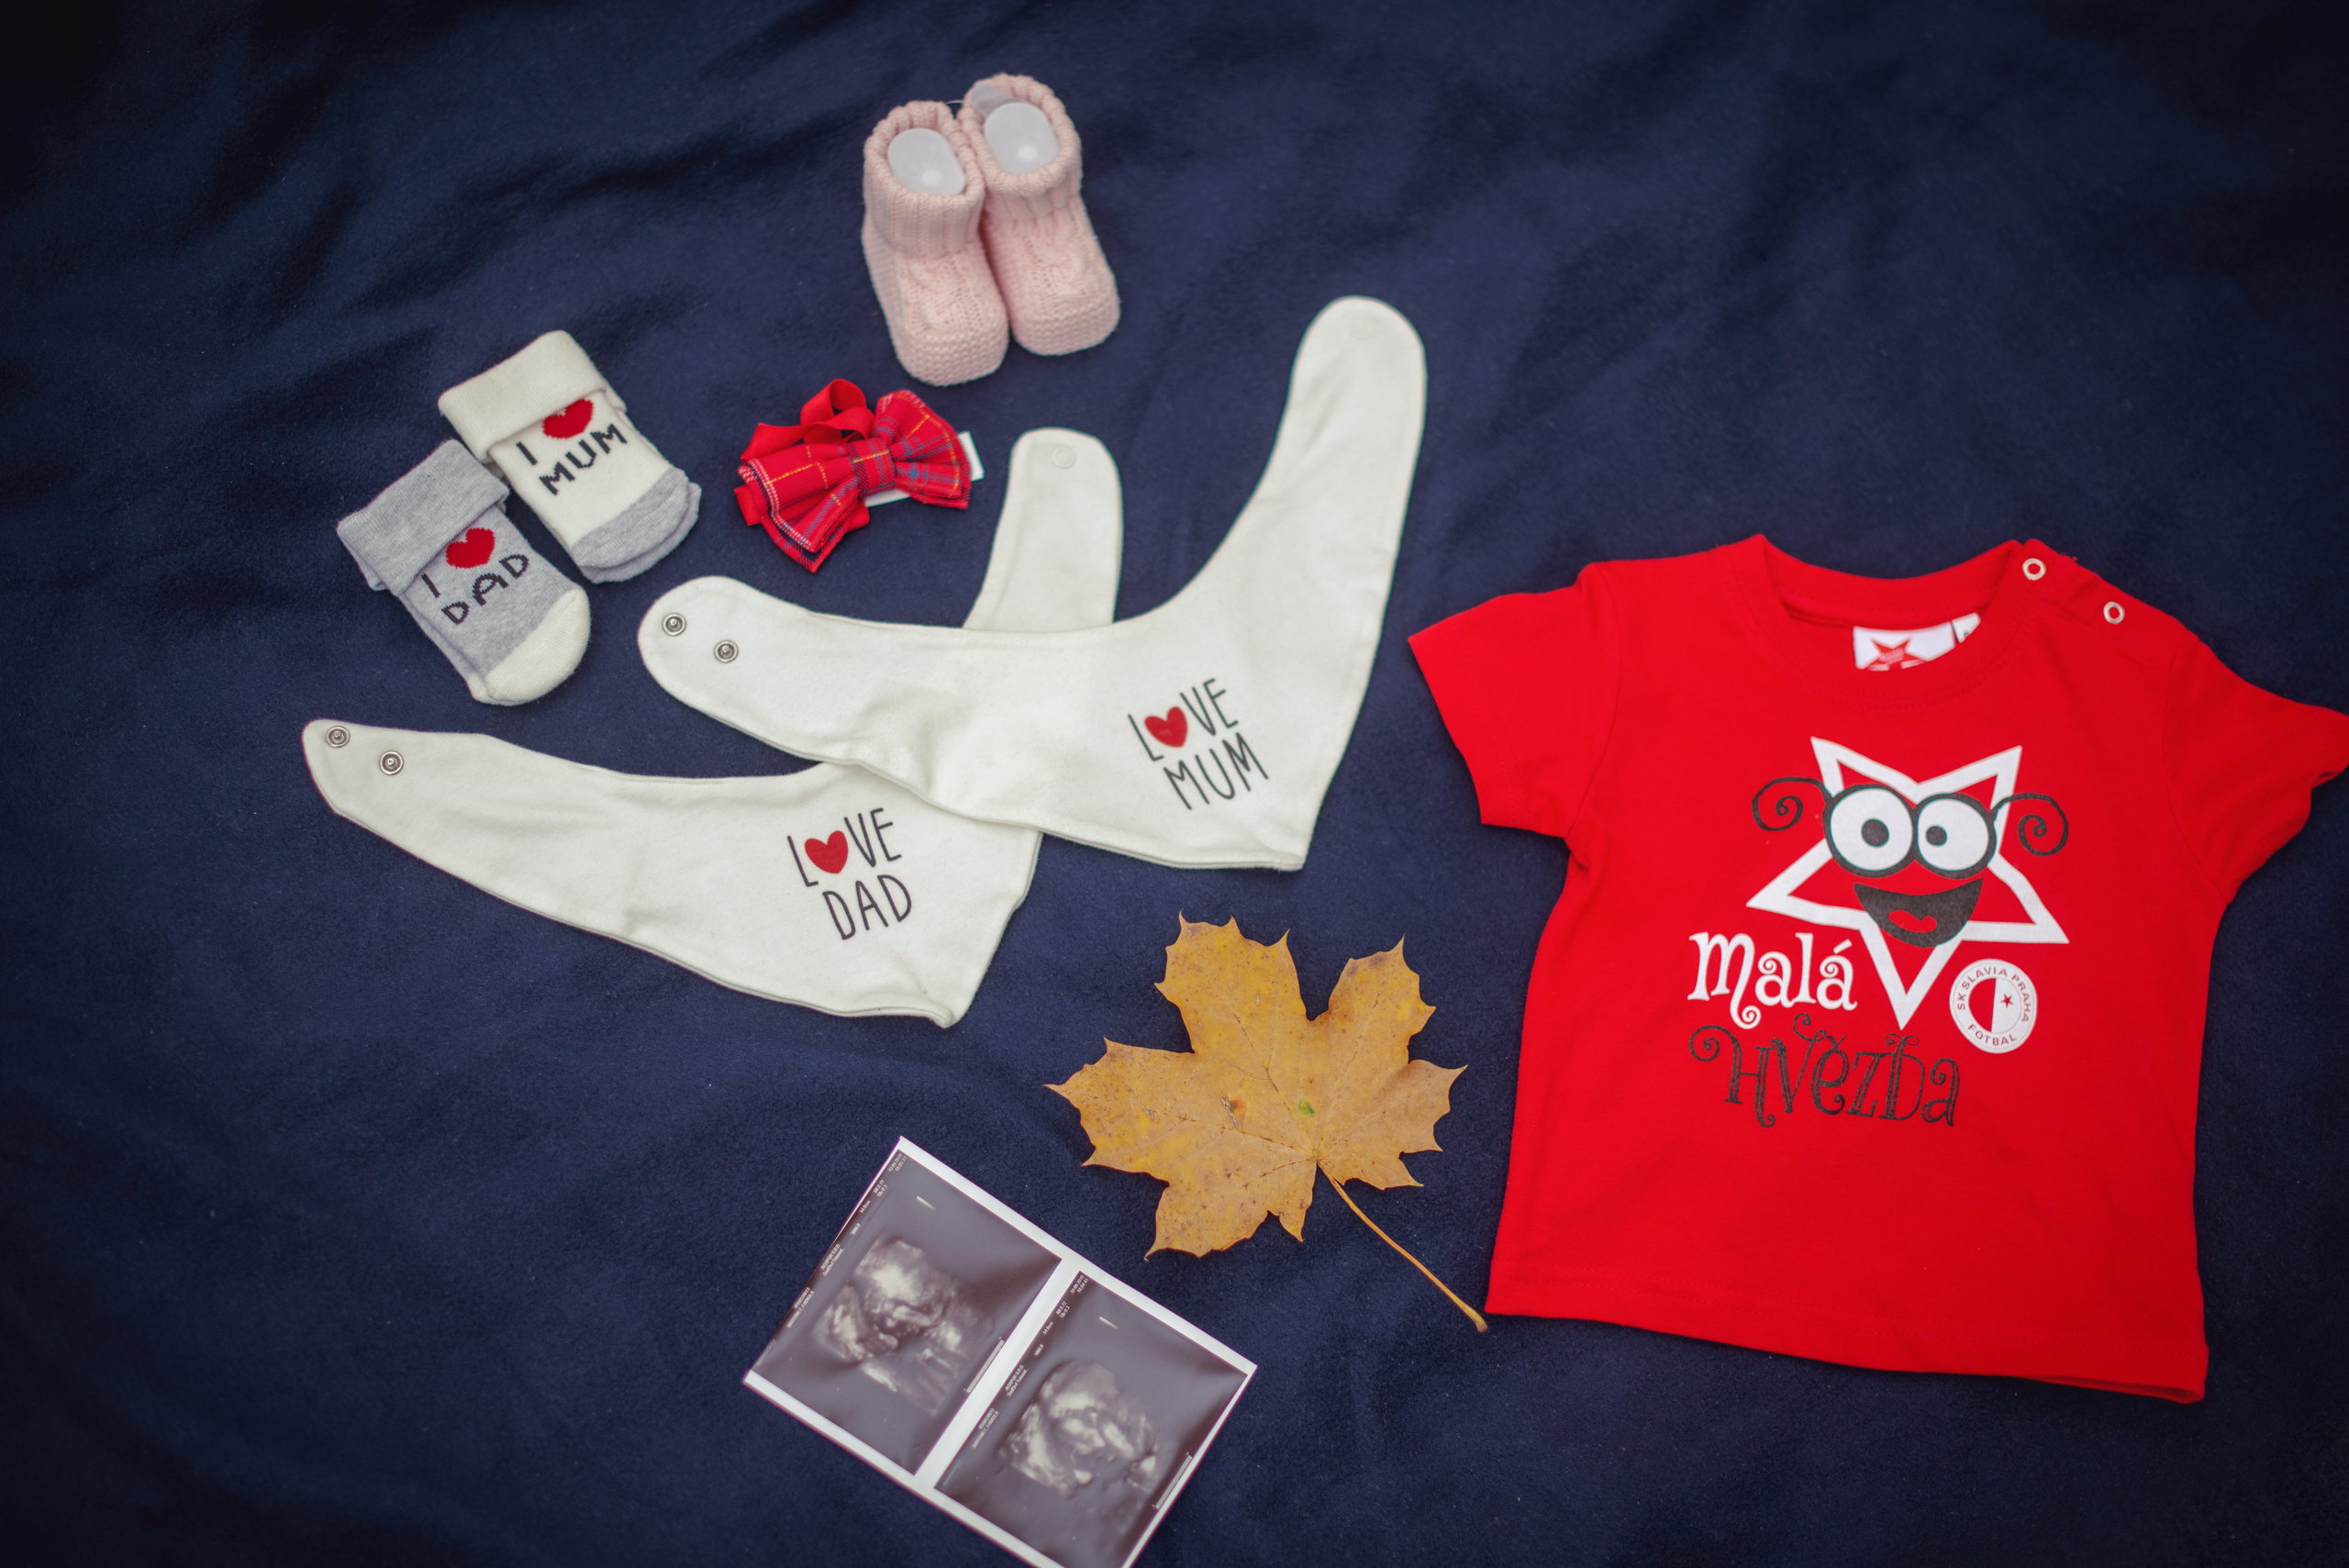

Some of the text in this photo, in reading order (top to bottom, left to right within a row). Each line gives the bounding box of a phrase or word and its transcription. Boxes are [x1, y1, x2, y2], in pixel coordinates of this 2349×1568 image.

[515, 441, 539, 466] I
[539, 423, 628, 495] MUM
[421, 573, 440, 598] I
[440, 553, 530, 626] DAD
[1162, 731, 1269, 810] MUM
[822, 873, 913, 940] DAD
[1956, 966, 2032, 1022] SK SLAVIA PRAHA
[1967, 1023, 2017, 1047] FOTBAL
